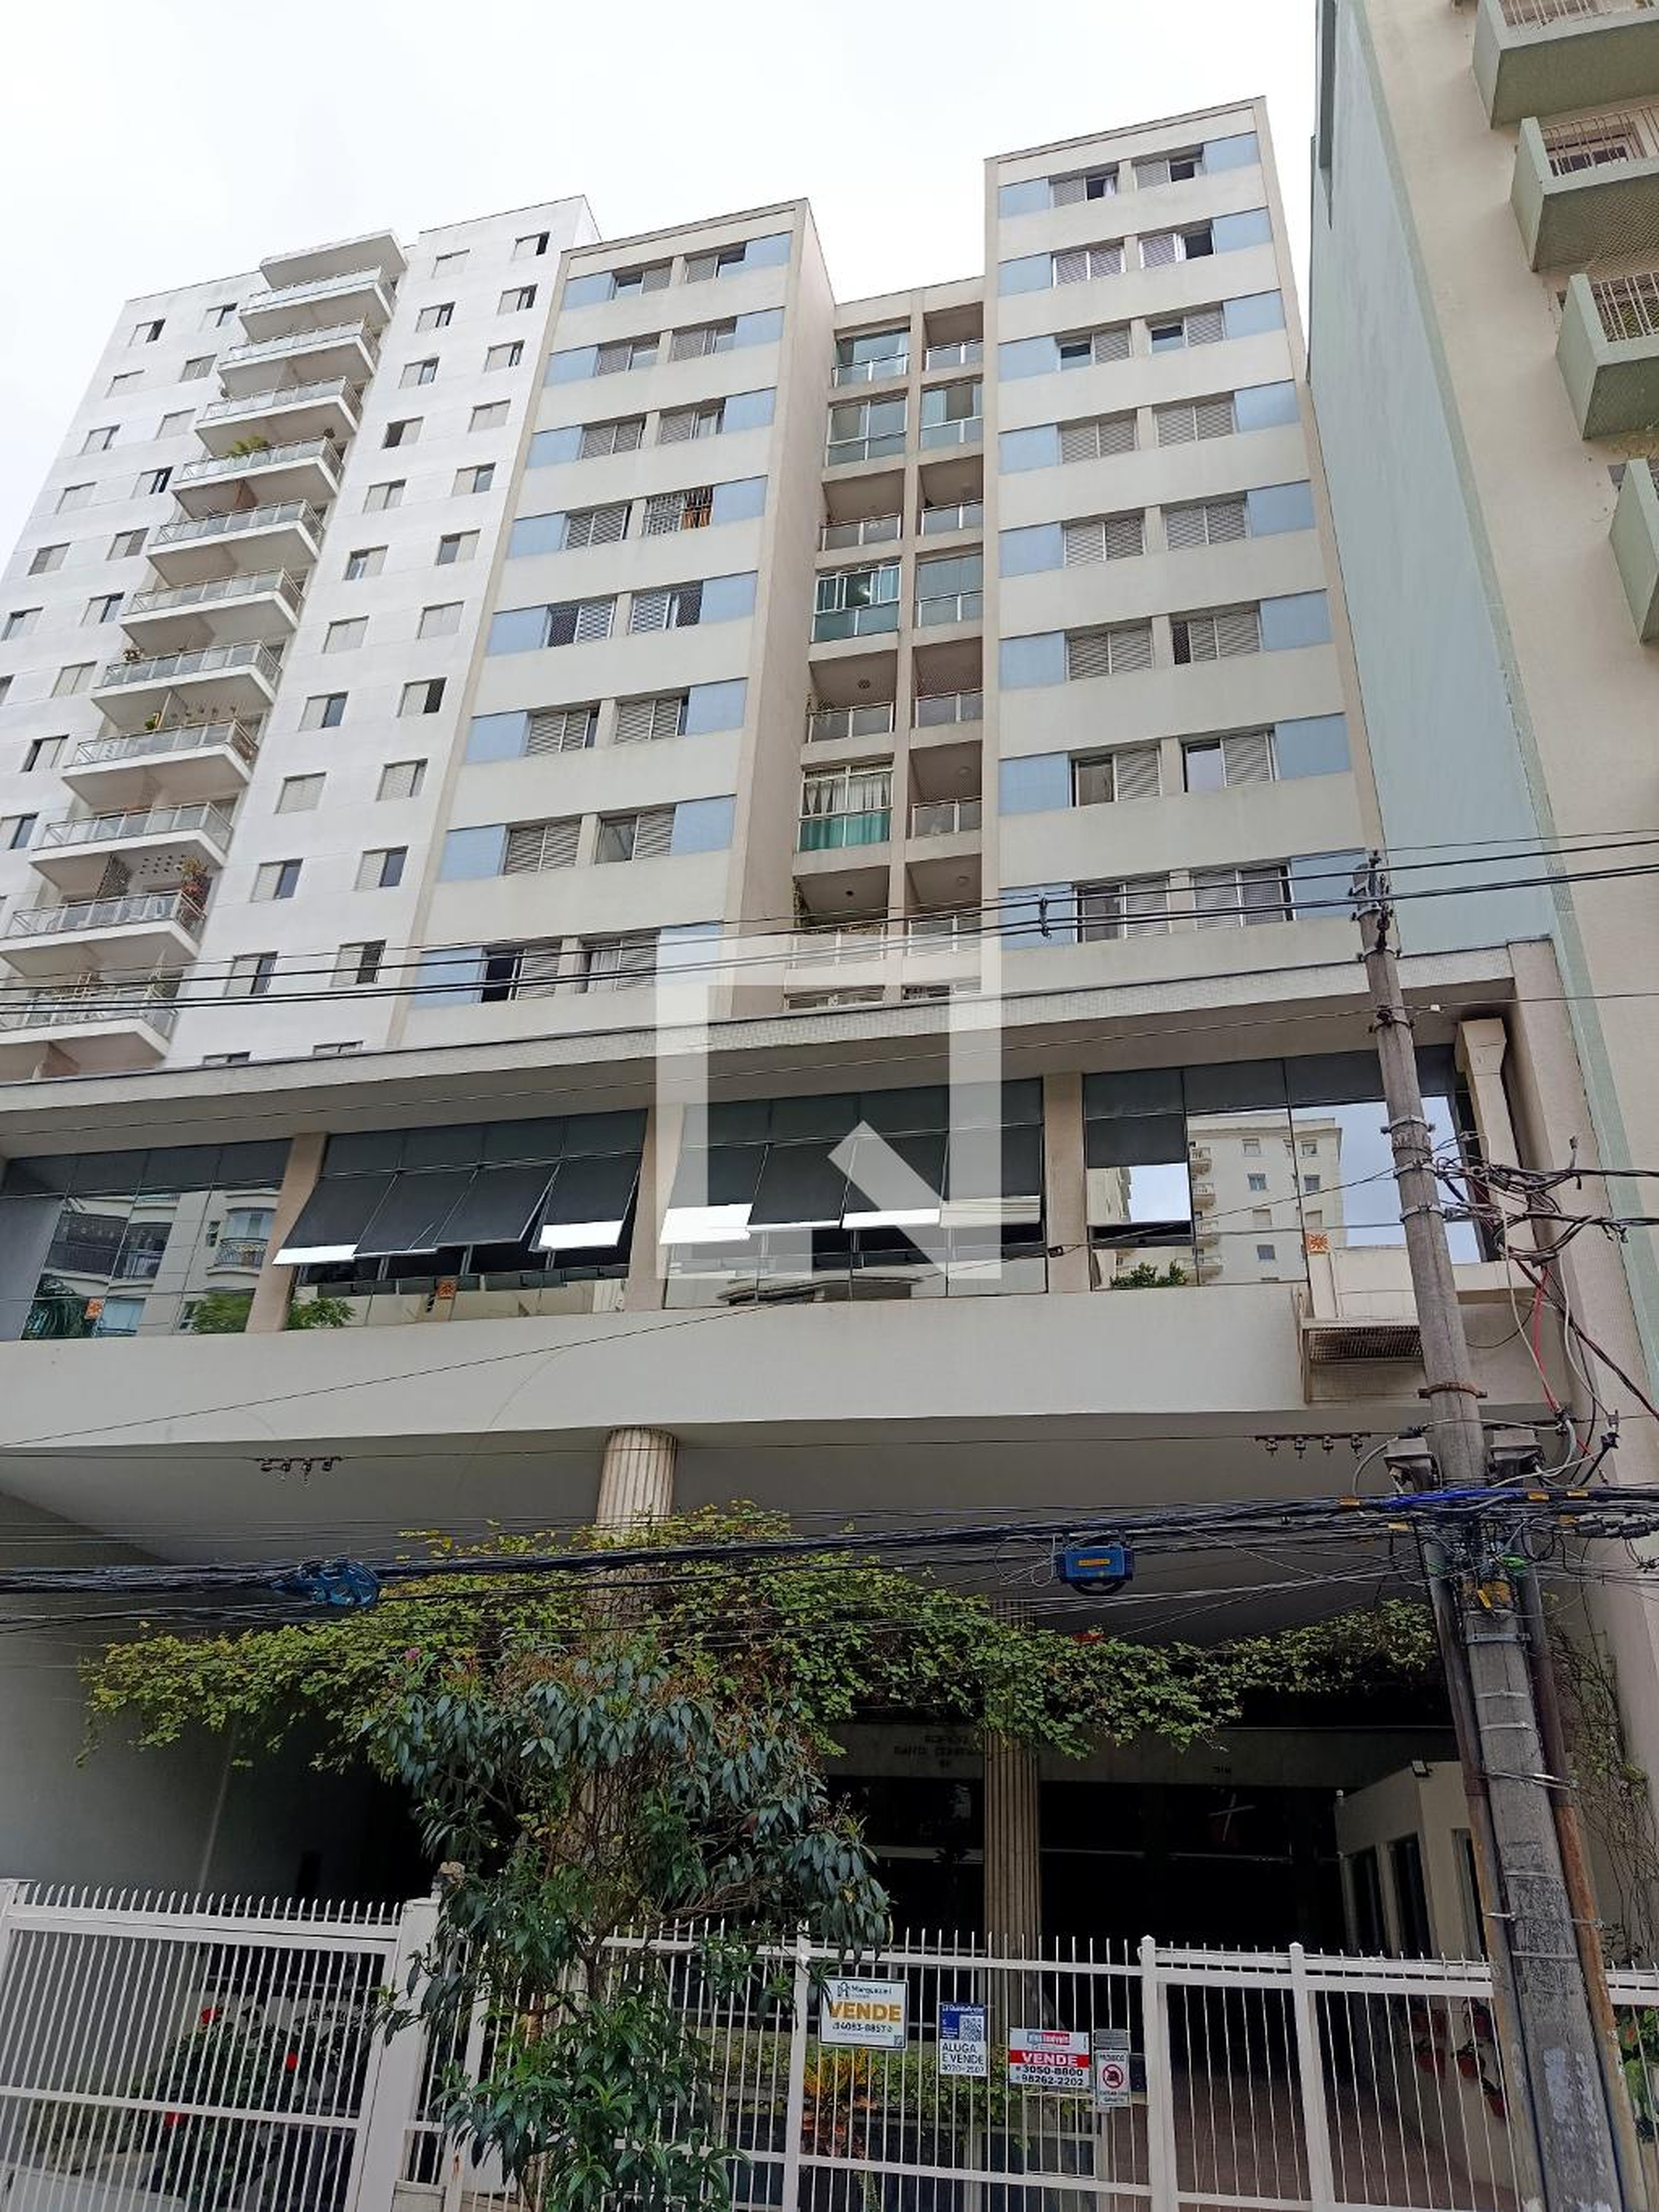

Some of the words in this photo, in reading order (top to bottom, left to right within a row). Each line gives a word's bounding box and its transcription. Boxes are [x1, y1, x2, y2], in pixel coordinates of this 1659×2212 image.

[830, 2001, 901, 2022] VENDE
[943, 2043, 976, 2053] ALUGA
[942, 2053, 947, 2062] E
[950, 2054, 984, 2065] VENDE
[1022, 2052, 1077, 2066] VENDE
[1022, 2074, 1084, 2086] 98262-2202
